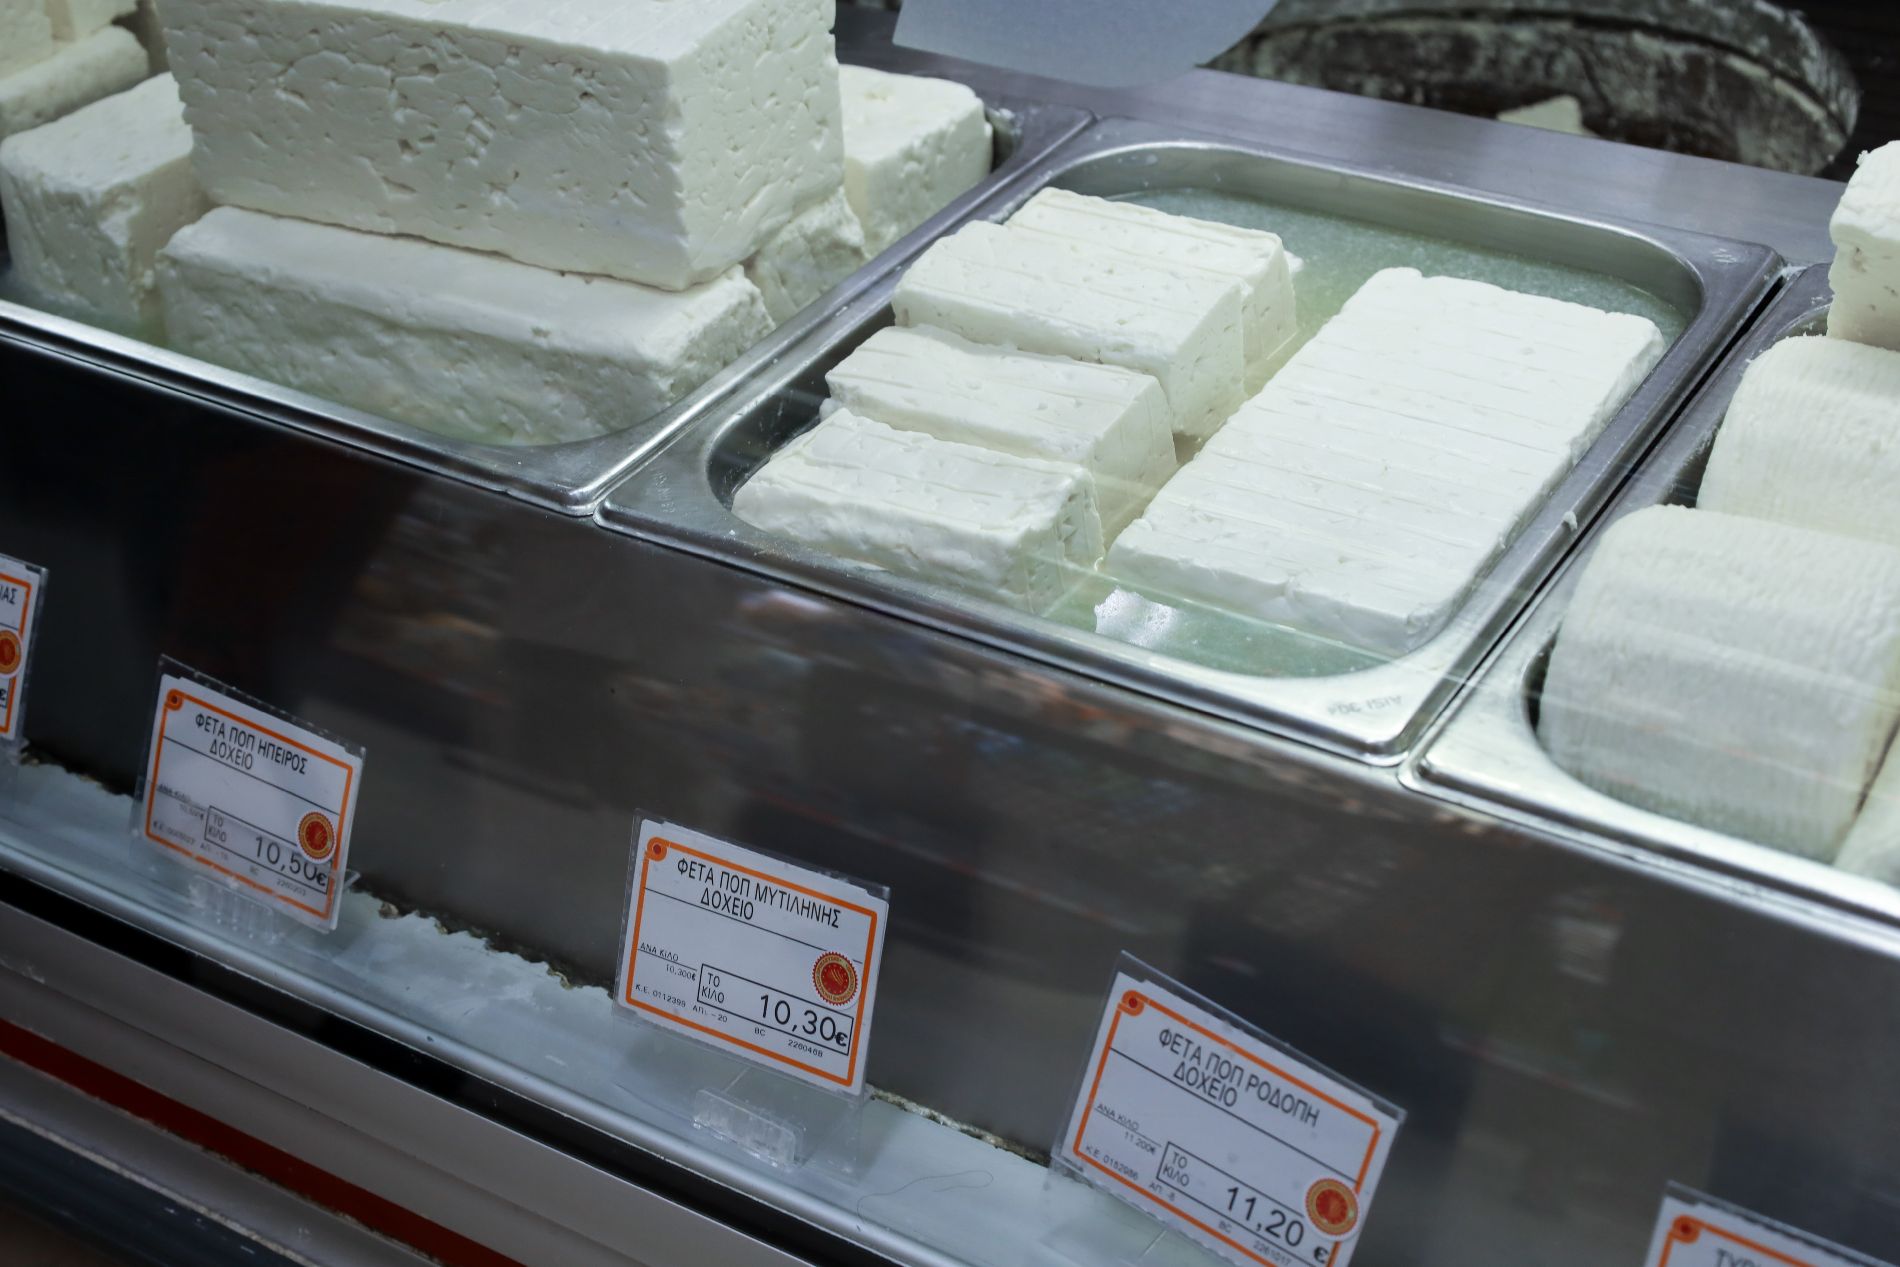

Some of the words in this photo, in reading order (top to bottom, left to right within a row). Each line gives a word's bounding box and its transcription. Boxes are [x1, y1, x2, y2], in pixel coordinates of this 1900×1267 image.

[195, 713, 226, 739] ΦΕΤΑ
[229, 726, 256, 752] ΠΟΠ
[257, 739, 308, 775] ΗΠΕΙΡΟΣ
[209, 739, 253, 770] ΔΟΧΕΙΟ
[212, 813, 224, 828] ΤΟ
[255, 835, 327, 887] 10,50€
[677, 858, 714, 886] ΦΕΤΑ
[719, 871, 751, 897] ΠΟΠ
[754, 883, 841, 929] ΜΥΤΙΛΗΝΗΣ
[700, 887, 754, 920] ΔΟΧΕΙΟ
[640, 942, 657, 955] ΑΝΑ
[659, 949, 679, 962] ΚΙΛΟ
[701, 985, 725, 1004] ΚΙΛΟ
[708, 972, 721, 988] ΤΟ
[760, 994, 848, 1047] 10,30€
[1159, 1028, 1202, 1066] ΦΕΤΑ
[1205, 1052, 1244, 1087] ΠΟΠ
[1245, 1073, 1321, 1127] ΡΟΔΟΠΗ
[1173, 1061, 1238, 1107] ΔΟΧΕΙΟ
[1097, 1103, 1116, 1118] ΑΝΑ
[1118, 1113, 1140, 1132] ΚΙΛΟ
[1162, 1163, 1190, 1187] ΚΙΛΟ
[1172, 1151, 1188, 1169] ΤΟ
[1227, 1186, 1305, 1247] 11,20
[1313, 1246, 1329, 1264] €
